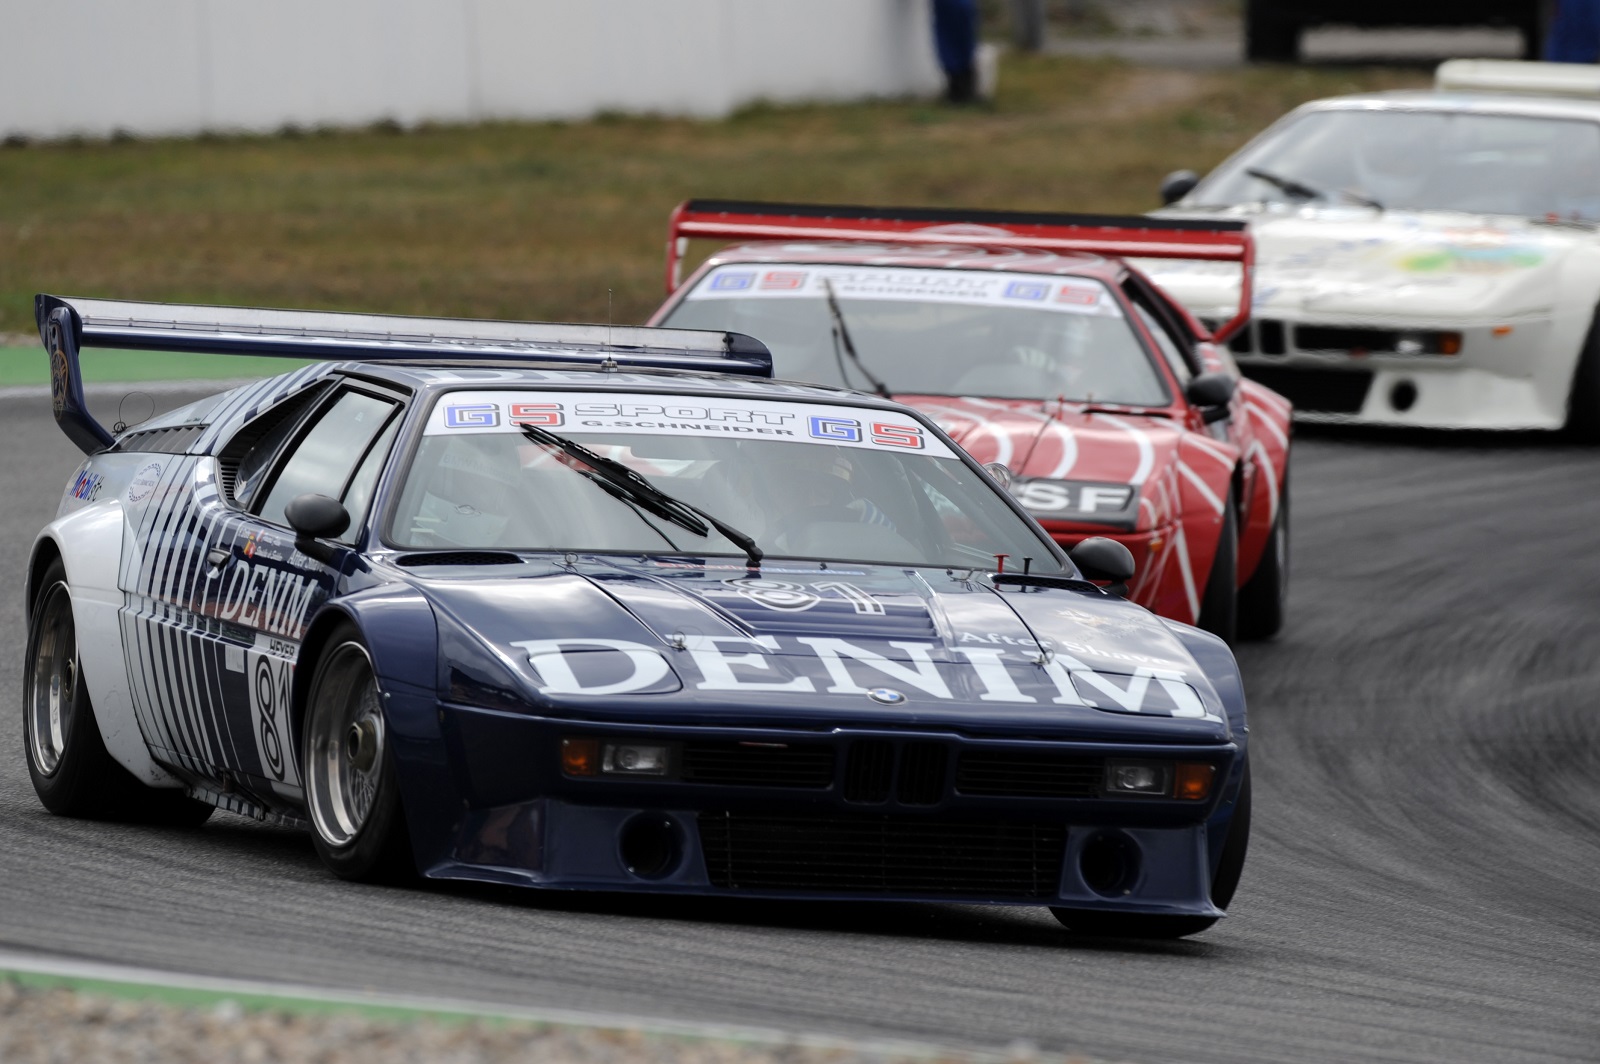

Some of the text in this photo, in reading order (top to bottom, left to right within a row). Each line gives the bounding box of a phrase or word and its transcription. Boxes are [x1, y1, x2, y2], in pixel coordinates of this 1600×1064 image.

[575, 403, 795, 426] SPORT
[70, 470, 99, 500] Mobil
[220, 559, 318, 640] DENIM
[721, 578, 886, 615] 81
[960, 632, 1169, 665] After Shave
[509, 633, 1222, 724] DENIM
[254, 655, 303, 788] 81
